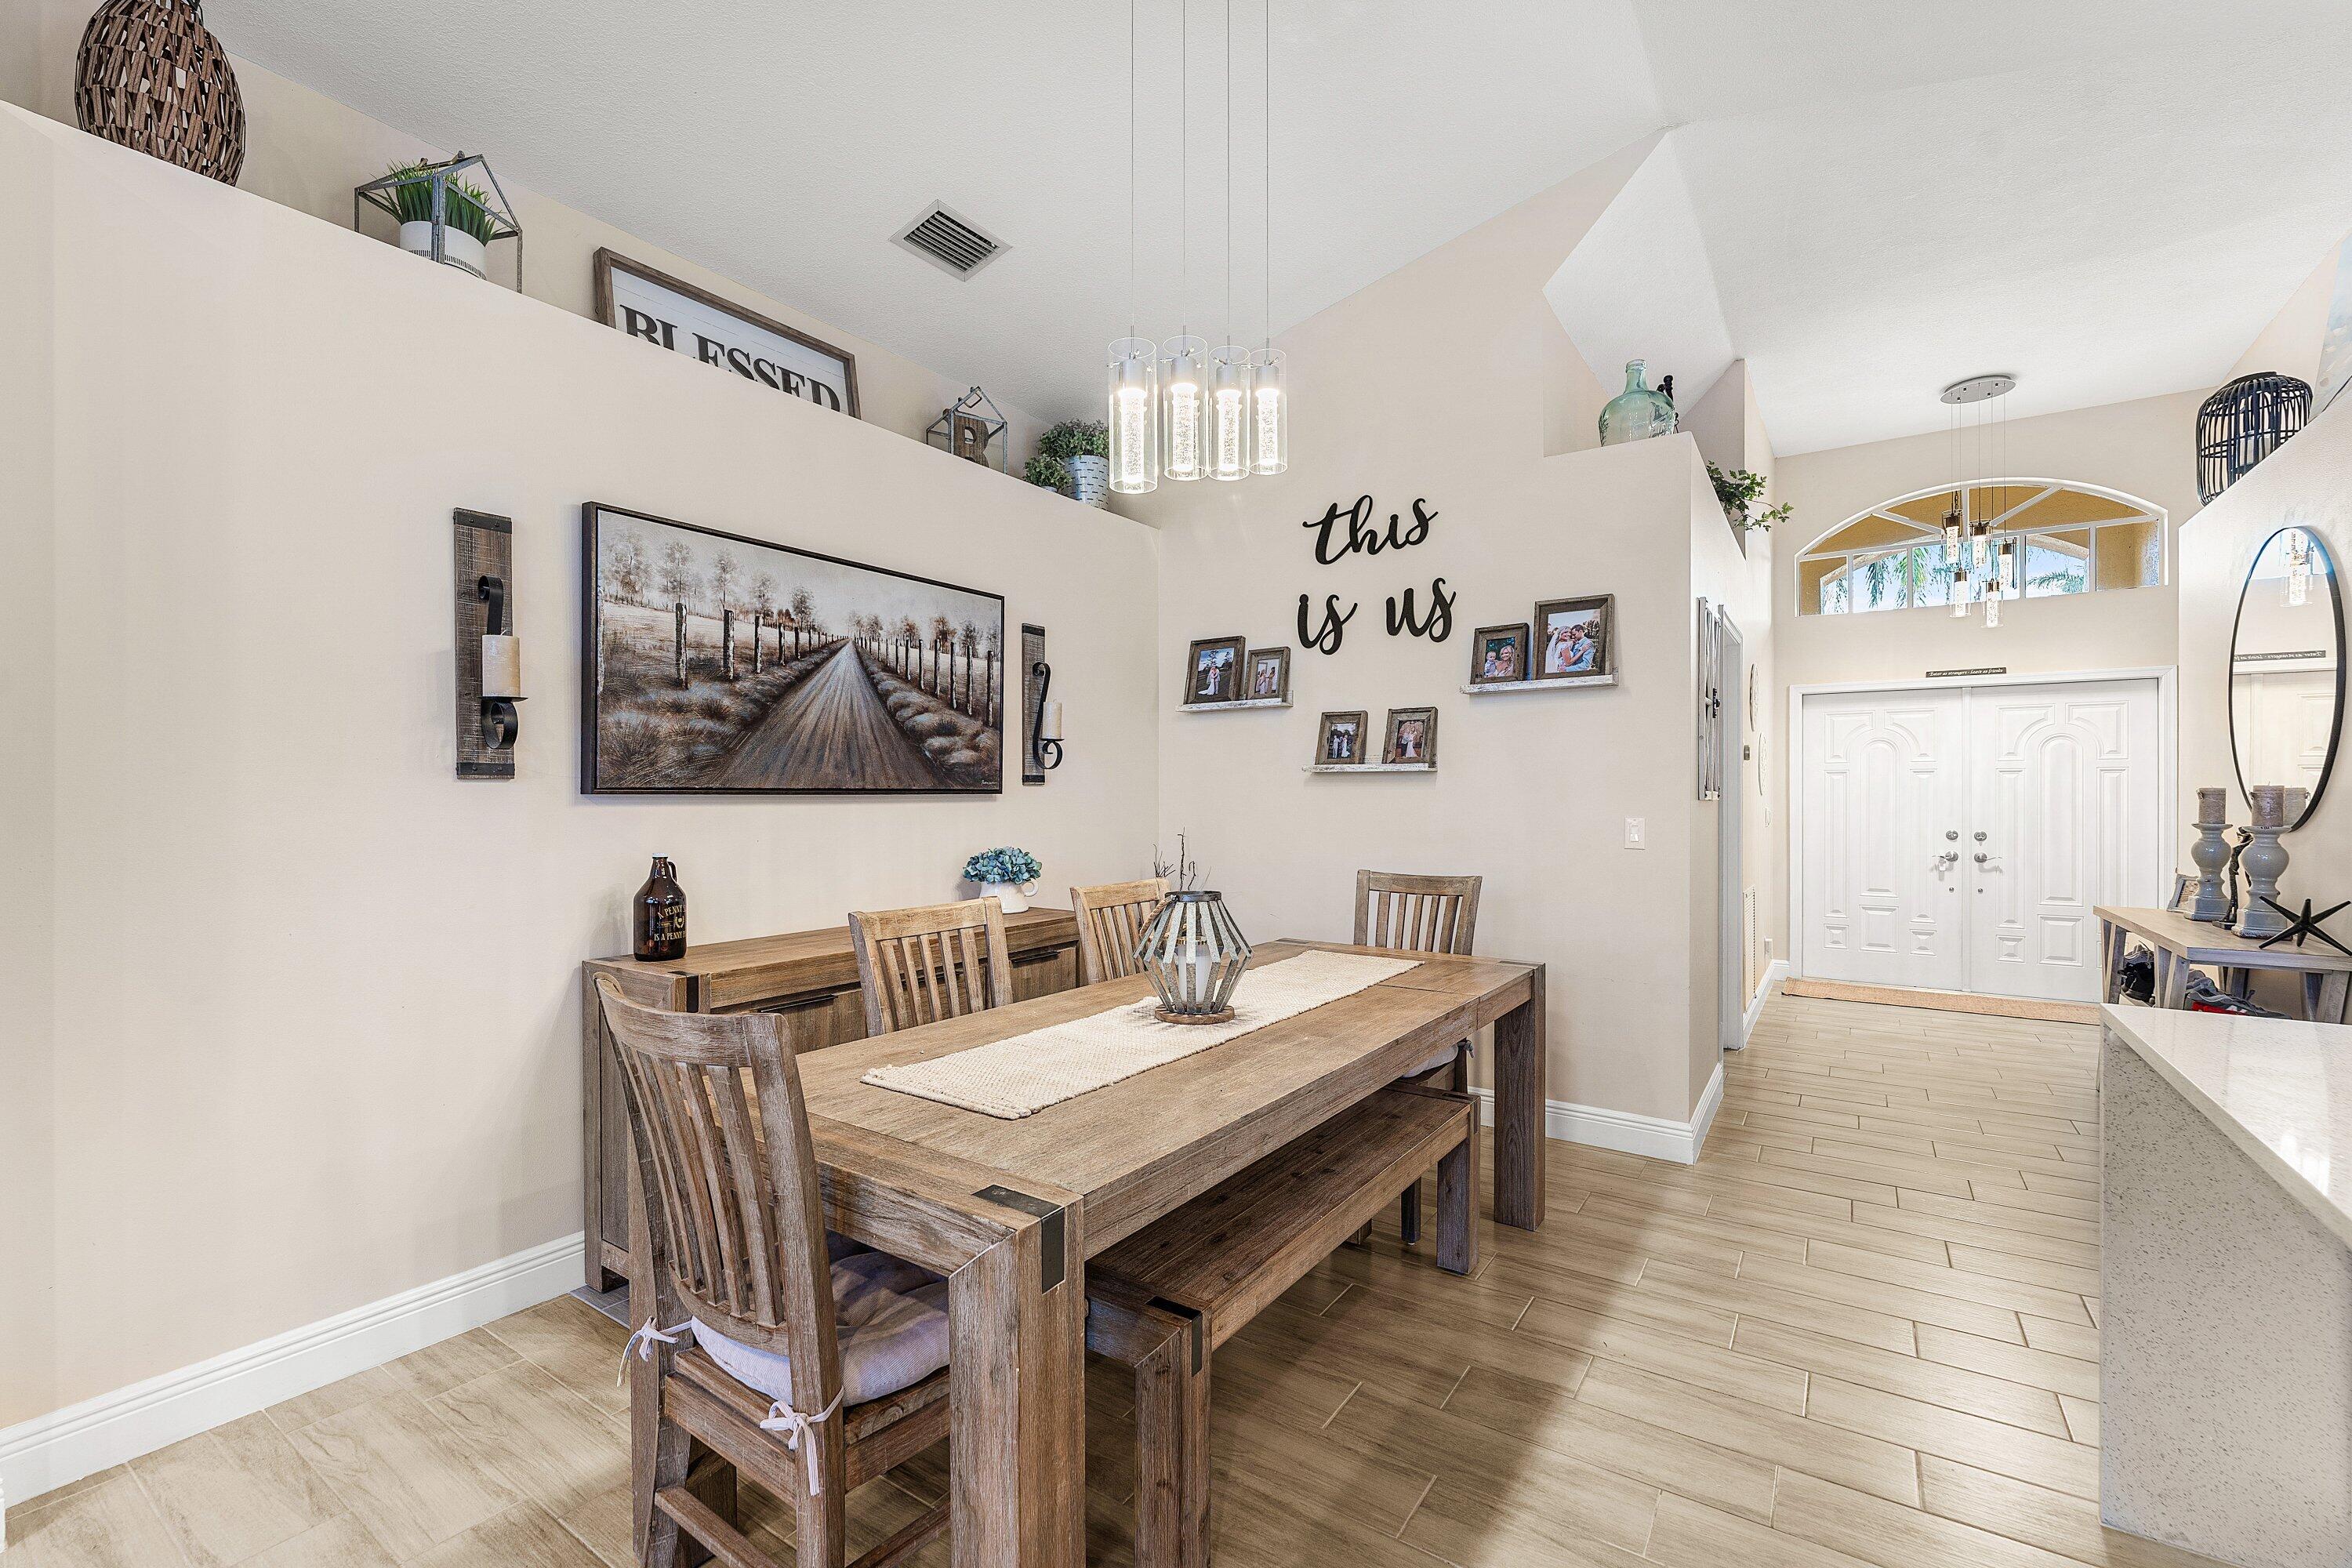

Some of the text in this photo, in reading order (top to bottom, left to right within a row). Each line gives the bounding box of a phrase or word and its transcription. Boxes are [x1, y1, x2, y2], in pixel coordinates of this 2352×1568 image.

[1302, 495, 1439, 564] this
[1298, 578, 1456, 655] is us
